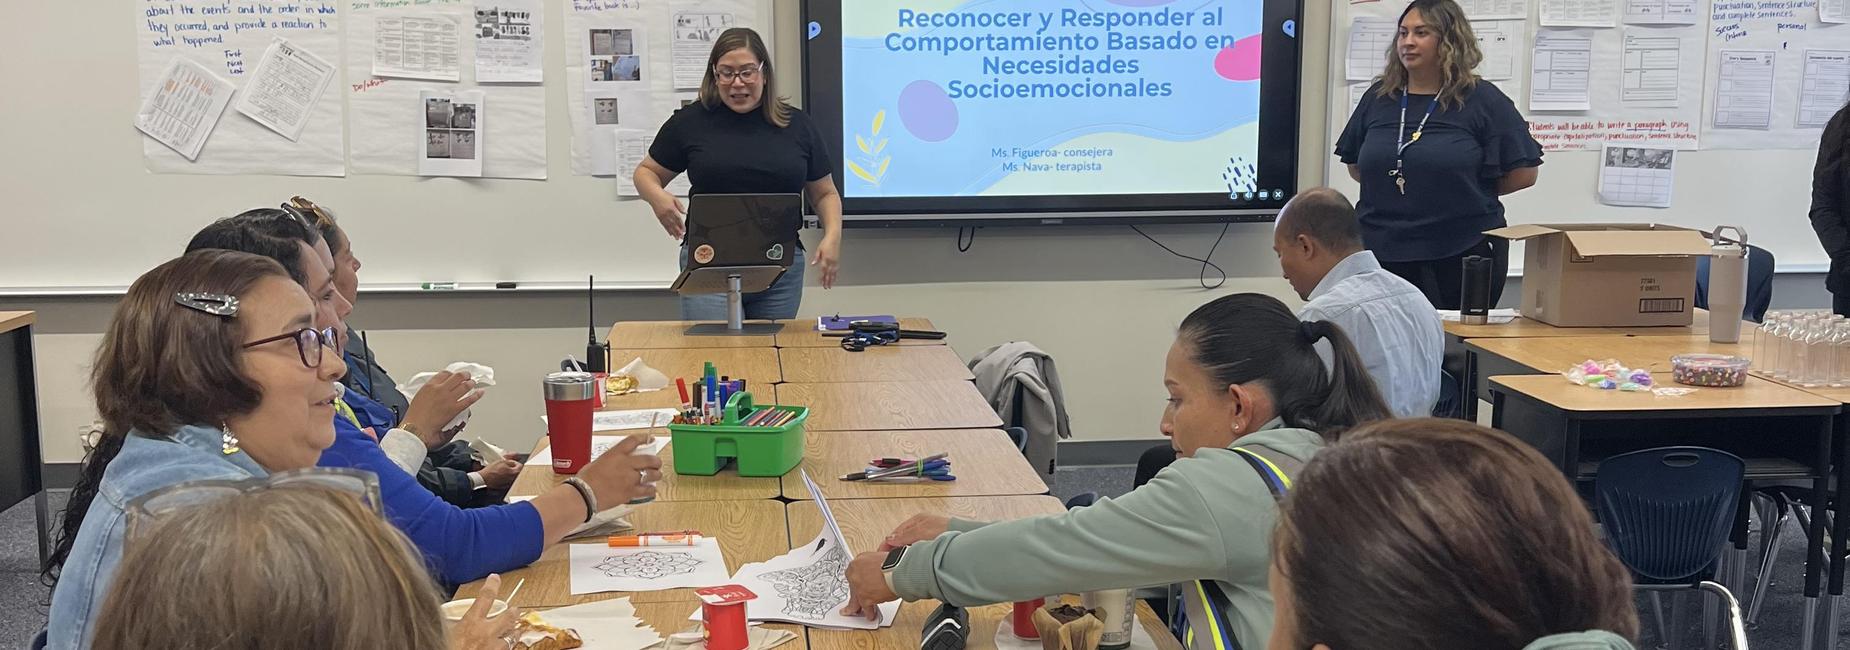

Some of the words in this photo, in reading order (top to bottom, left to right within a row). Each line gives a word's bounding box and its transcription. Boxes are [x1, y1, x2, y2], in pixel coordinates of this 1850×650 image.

[146, 4, 174, 17] about
[180, 4, 194, 15] the
[201, 3, 231, 15] events
[237, 4, 254, 14] and
[258, 4, 272, 14] the
[278, 3, 300, 14] order
[305, 6, 315, 14] in
[317, 3, 336, 15] which
[212, 21, 229, 31] and
[234, 18, 267, 34] provide
[271, 21, 278, 29] a
[281, 17, 314, 29] reaction
[319, 18, 328, 29] to
[898, 8, 1032, 28] Reconocer
[1038, 12, 1054, 32] y
[1061, 6, 1195, 31] Responder
[1201, 6, 1223, 27] al
[153, 35, 176, 47] what
[884, 31, 1099, 56] Comportamiento
[1107, 30, 1198, 51] Basado
[1204, 34, 1235, 49] en
[982, 54, 1140, 75] Necesidades
[947, 77, 1173, 99] Socioemocionales
[1607, 120, 1625, 129] write
[991, 147, 1009, 158] Ms.
[1012, 147, 1061, 160] Figueroa-
[1063, 147, 1114, 158] consejera
[1002, 162, 1019, 172] Ms.
[1023, 162, 1054, 172] Nava-
[1055, 162, 1102, 173] terapista
